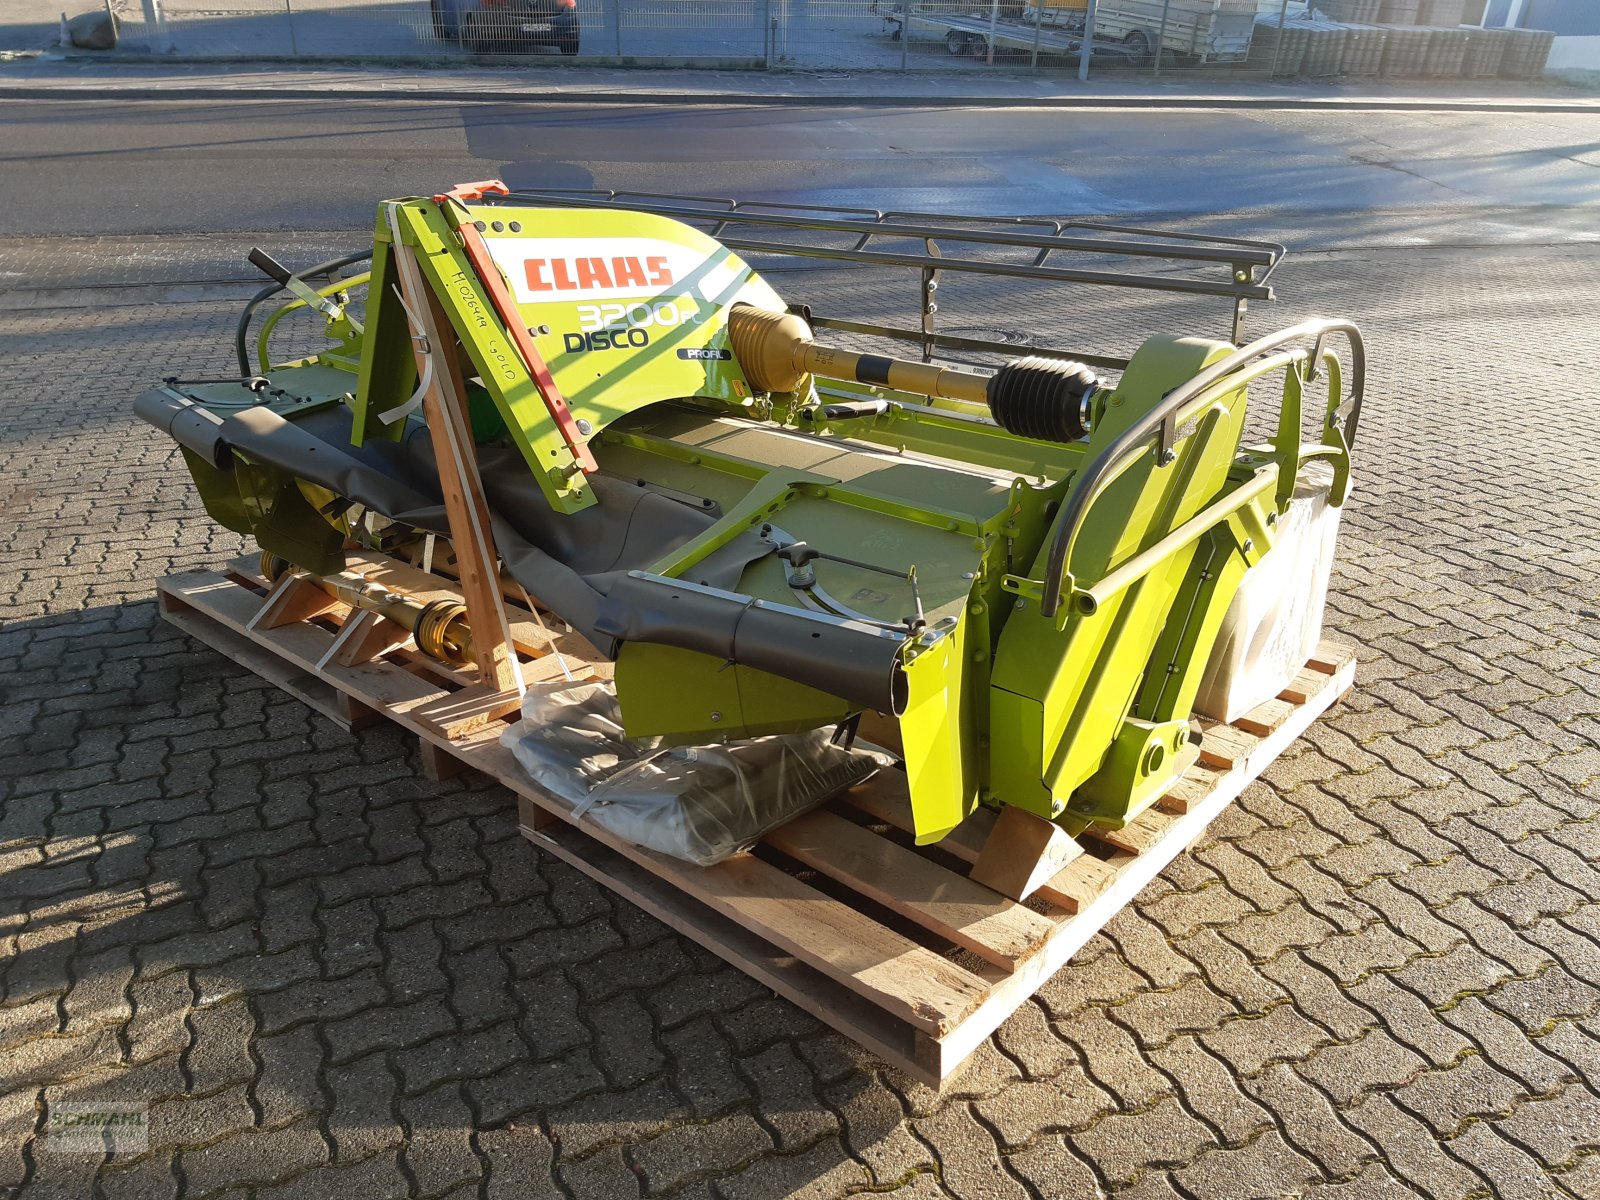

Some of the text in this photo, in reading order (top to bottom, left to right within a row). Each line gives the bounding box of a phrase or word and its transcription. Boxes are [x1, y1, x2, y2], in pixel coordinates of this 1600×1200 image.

[523, 256, 673, 291] CLAAS
[563, 328, 649, 353] DISCO
[687, 348, 724, 359] PROFIL
